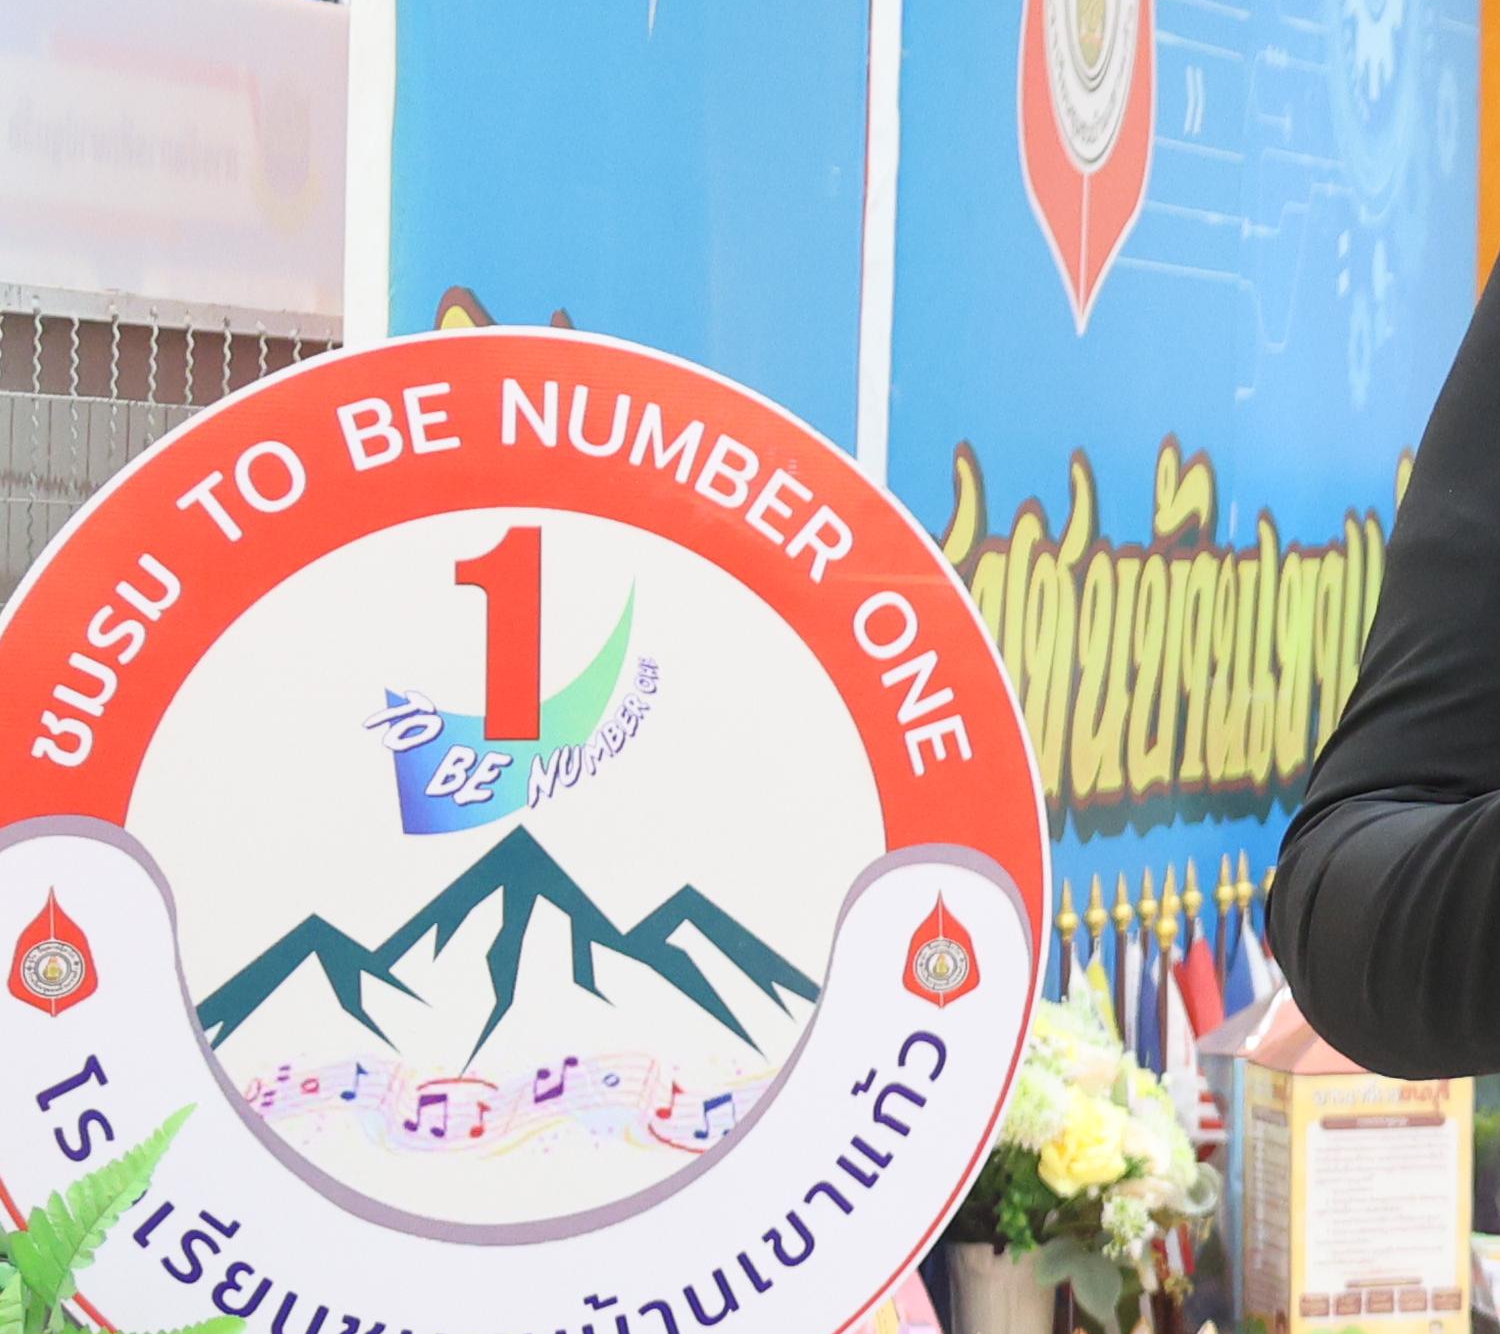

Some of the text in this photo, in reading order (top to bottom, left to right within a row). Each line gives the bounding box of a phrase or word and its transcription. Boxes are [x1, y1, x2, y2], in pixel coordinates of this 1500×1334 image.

[31, 378, 974, 779] ชมรม TO BE NUMBER ONE
[454, 525, 543, 743] 1
[362, 690, 445, 753] TO
[424, 743, 513, 808] BE
[526, 693, 652, 809] NUMBER
